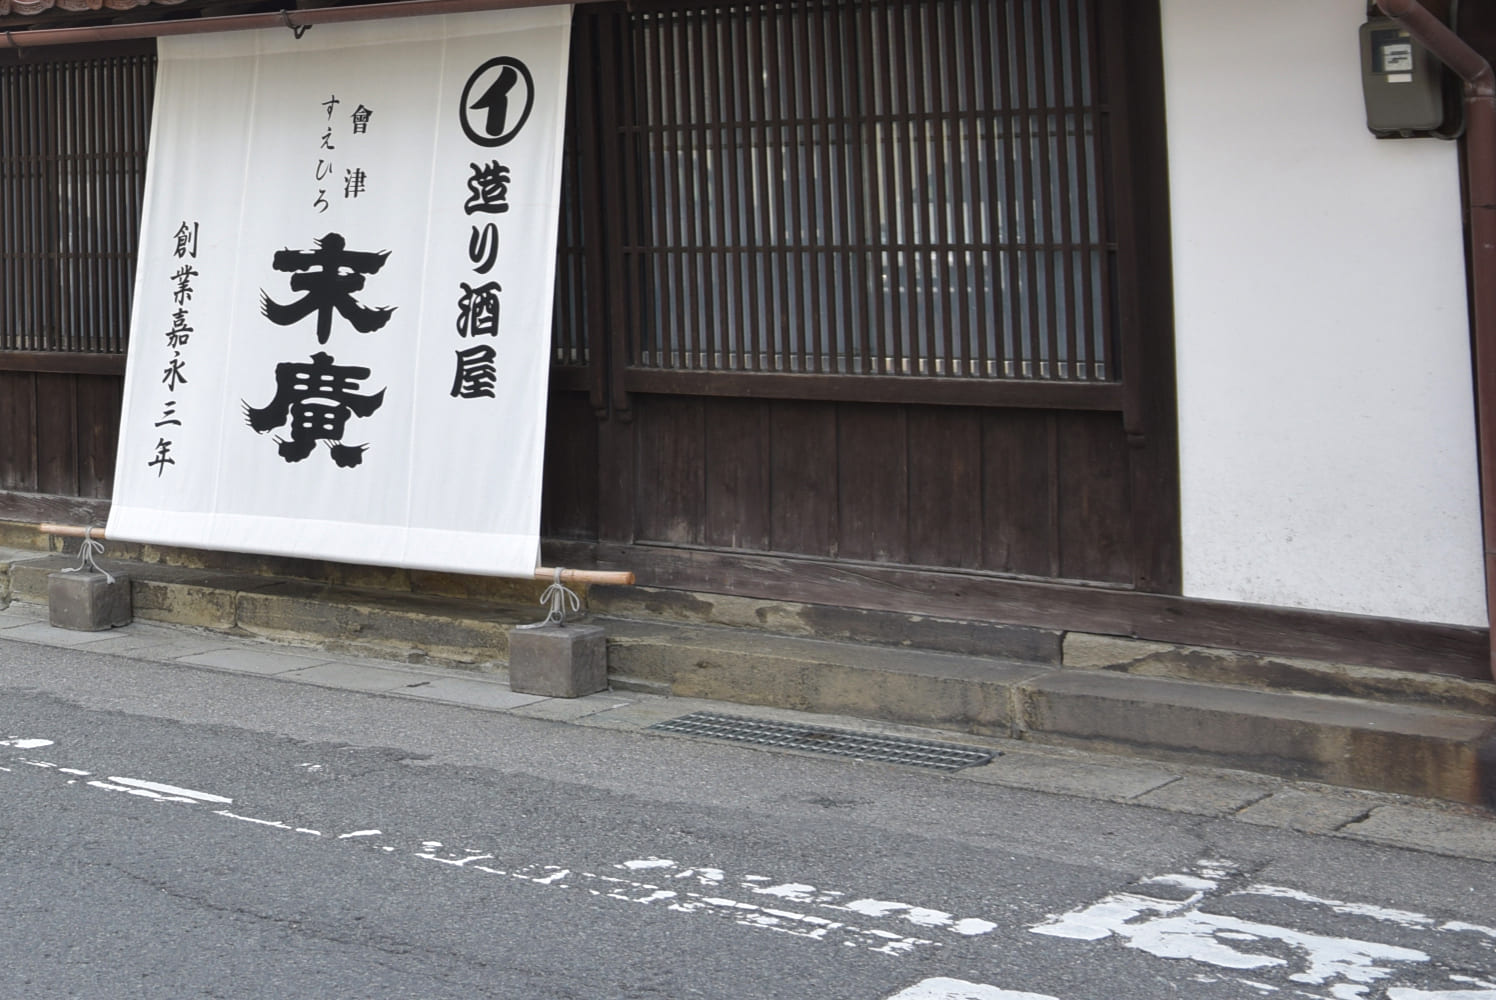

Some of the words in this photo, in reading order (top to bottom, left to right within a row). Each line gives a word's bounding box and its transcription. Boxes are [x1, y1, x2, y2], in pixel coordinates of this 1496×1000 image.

[313, 94, 341, 215] すえひろ
[343, 104, 374, 200] 會津
[147, 220, 199, 479] 創業嘉永三年
[241, 233, 398, 469] 末廣
[450, 160, 512, 400] 造り酒屋
